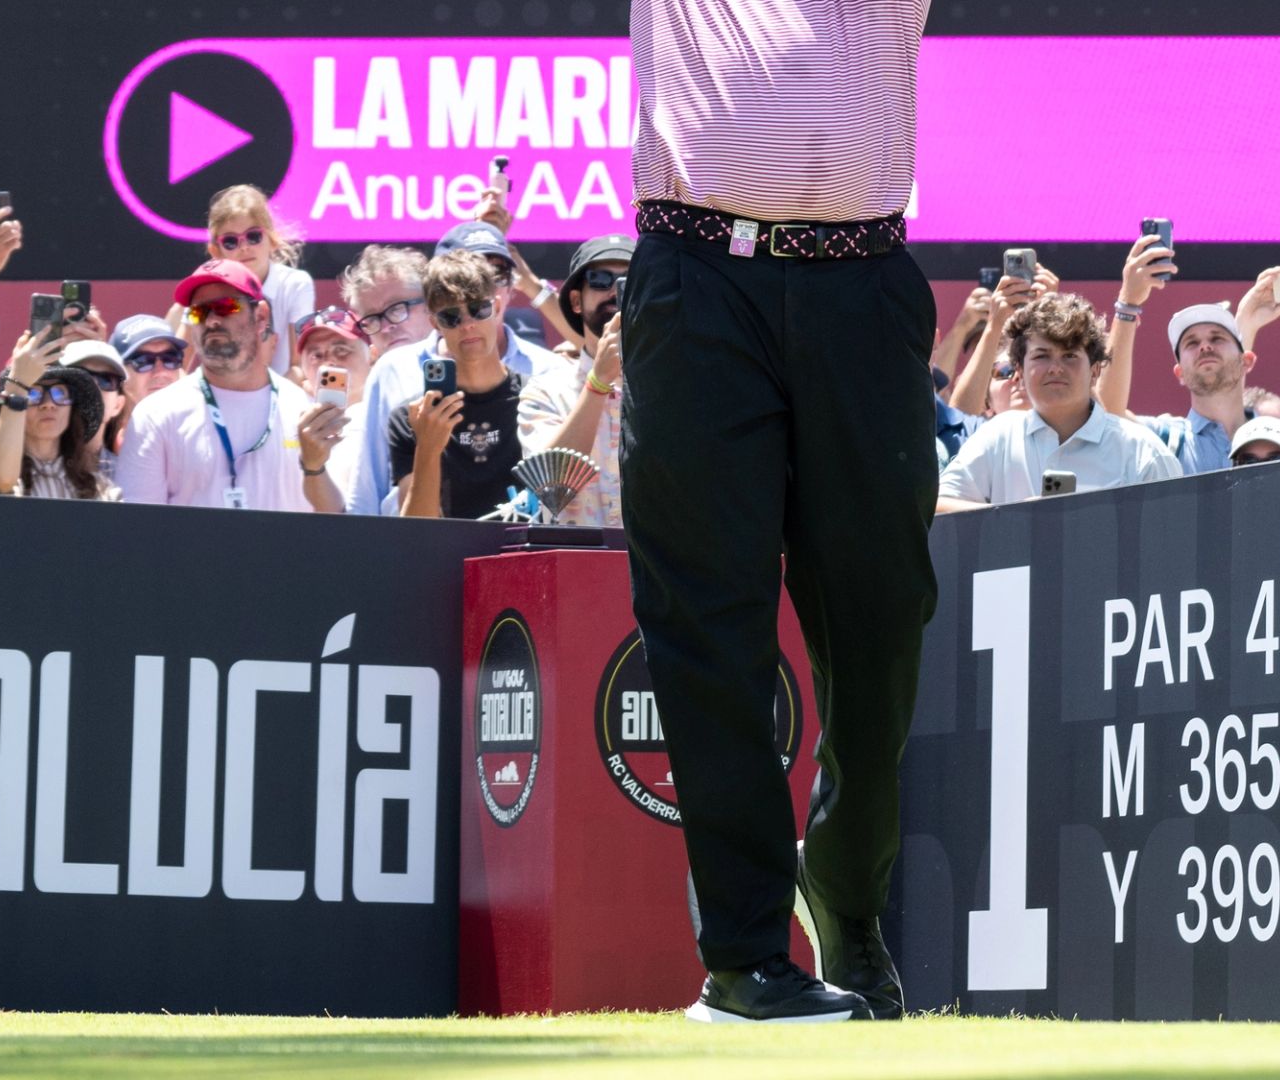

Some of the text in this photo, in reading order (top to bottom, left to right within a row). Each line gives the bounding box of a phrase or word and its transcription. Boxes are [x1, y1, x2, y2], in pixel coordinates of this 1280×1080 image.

[312, 56, 640, 149] LA MARI
[309, 161, 624, 220] Anue AA
[1103, 579, 1280, 691] PAR 4
[608, 754, 682, 822] RC VALDERR
[967, 565, 1048, 992] 1
[1102, 722, 1145, 818] M
[1102, 842, 1280, 944] Y 399
